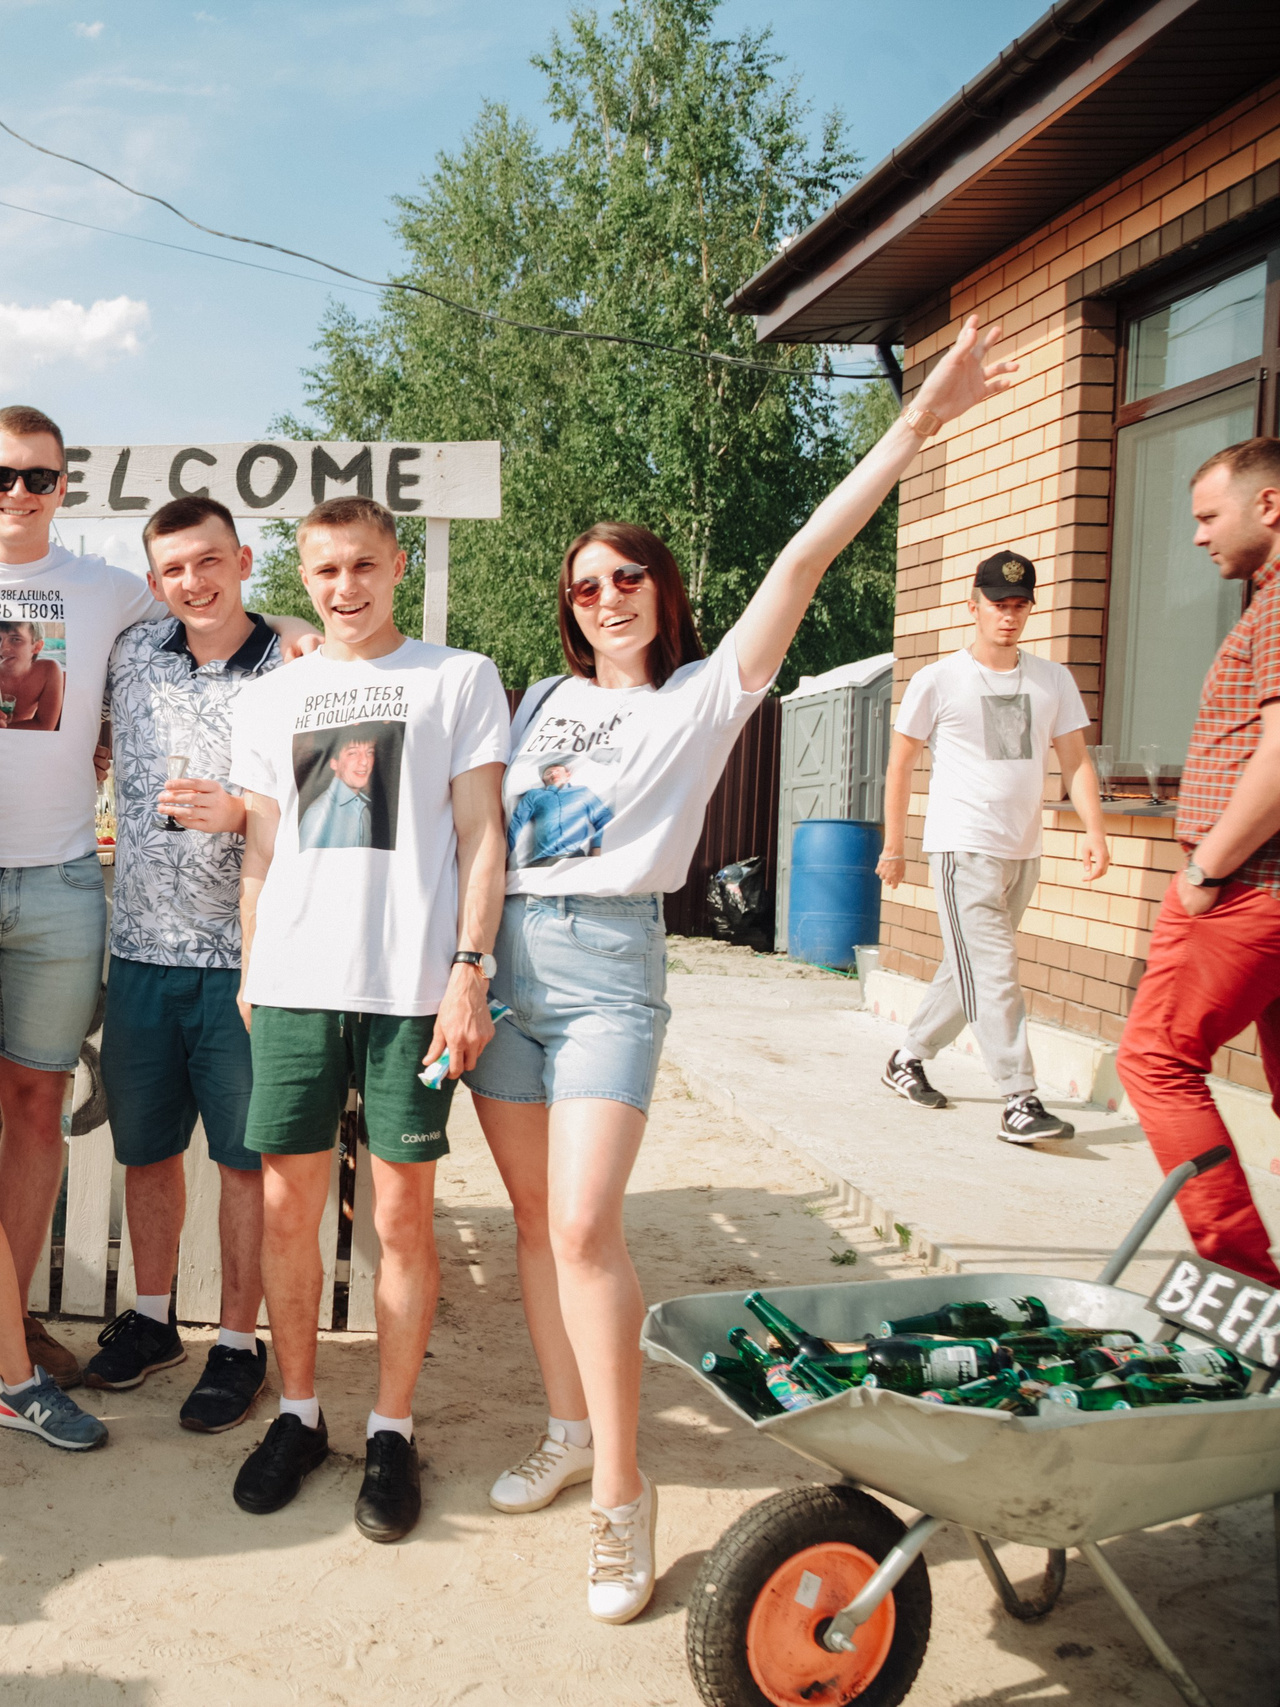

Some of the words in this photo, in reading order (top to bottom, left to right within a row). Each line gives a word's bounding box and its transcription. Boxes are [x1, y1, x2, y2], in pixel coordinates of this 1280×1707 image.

[18, 603, 65, 620] ТВОЯ!
[304, 688, 358, 713] ВРЕМЯ
[364, 686, 404, 701] ТЕБЯ
[295, 714, 312, 729] НЕ
[316, 703, 409, 727] ПОЩАДИЛО!
[1156, 1261, 1280, 1367] BEER
[24, 1401, 52, 1427] N
